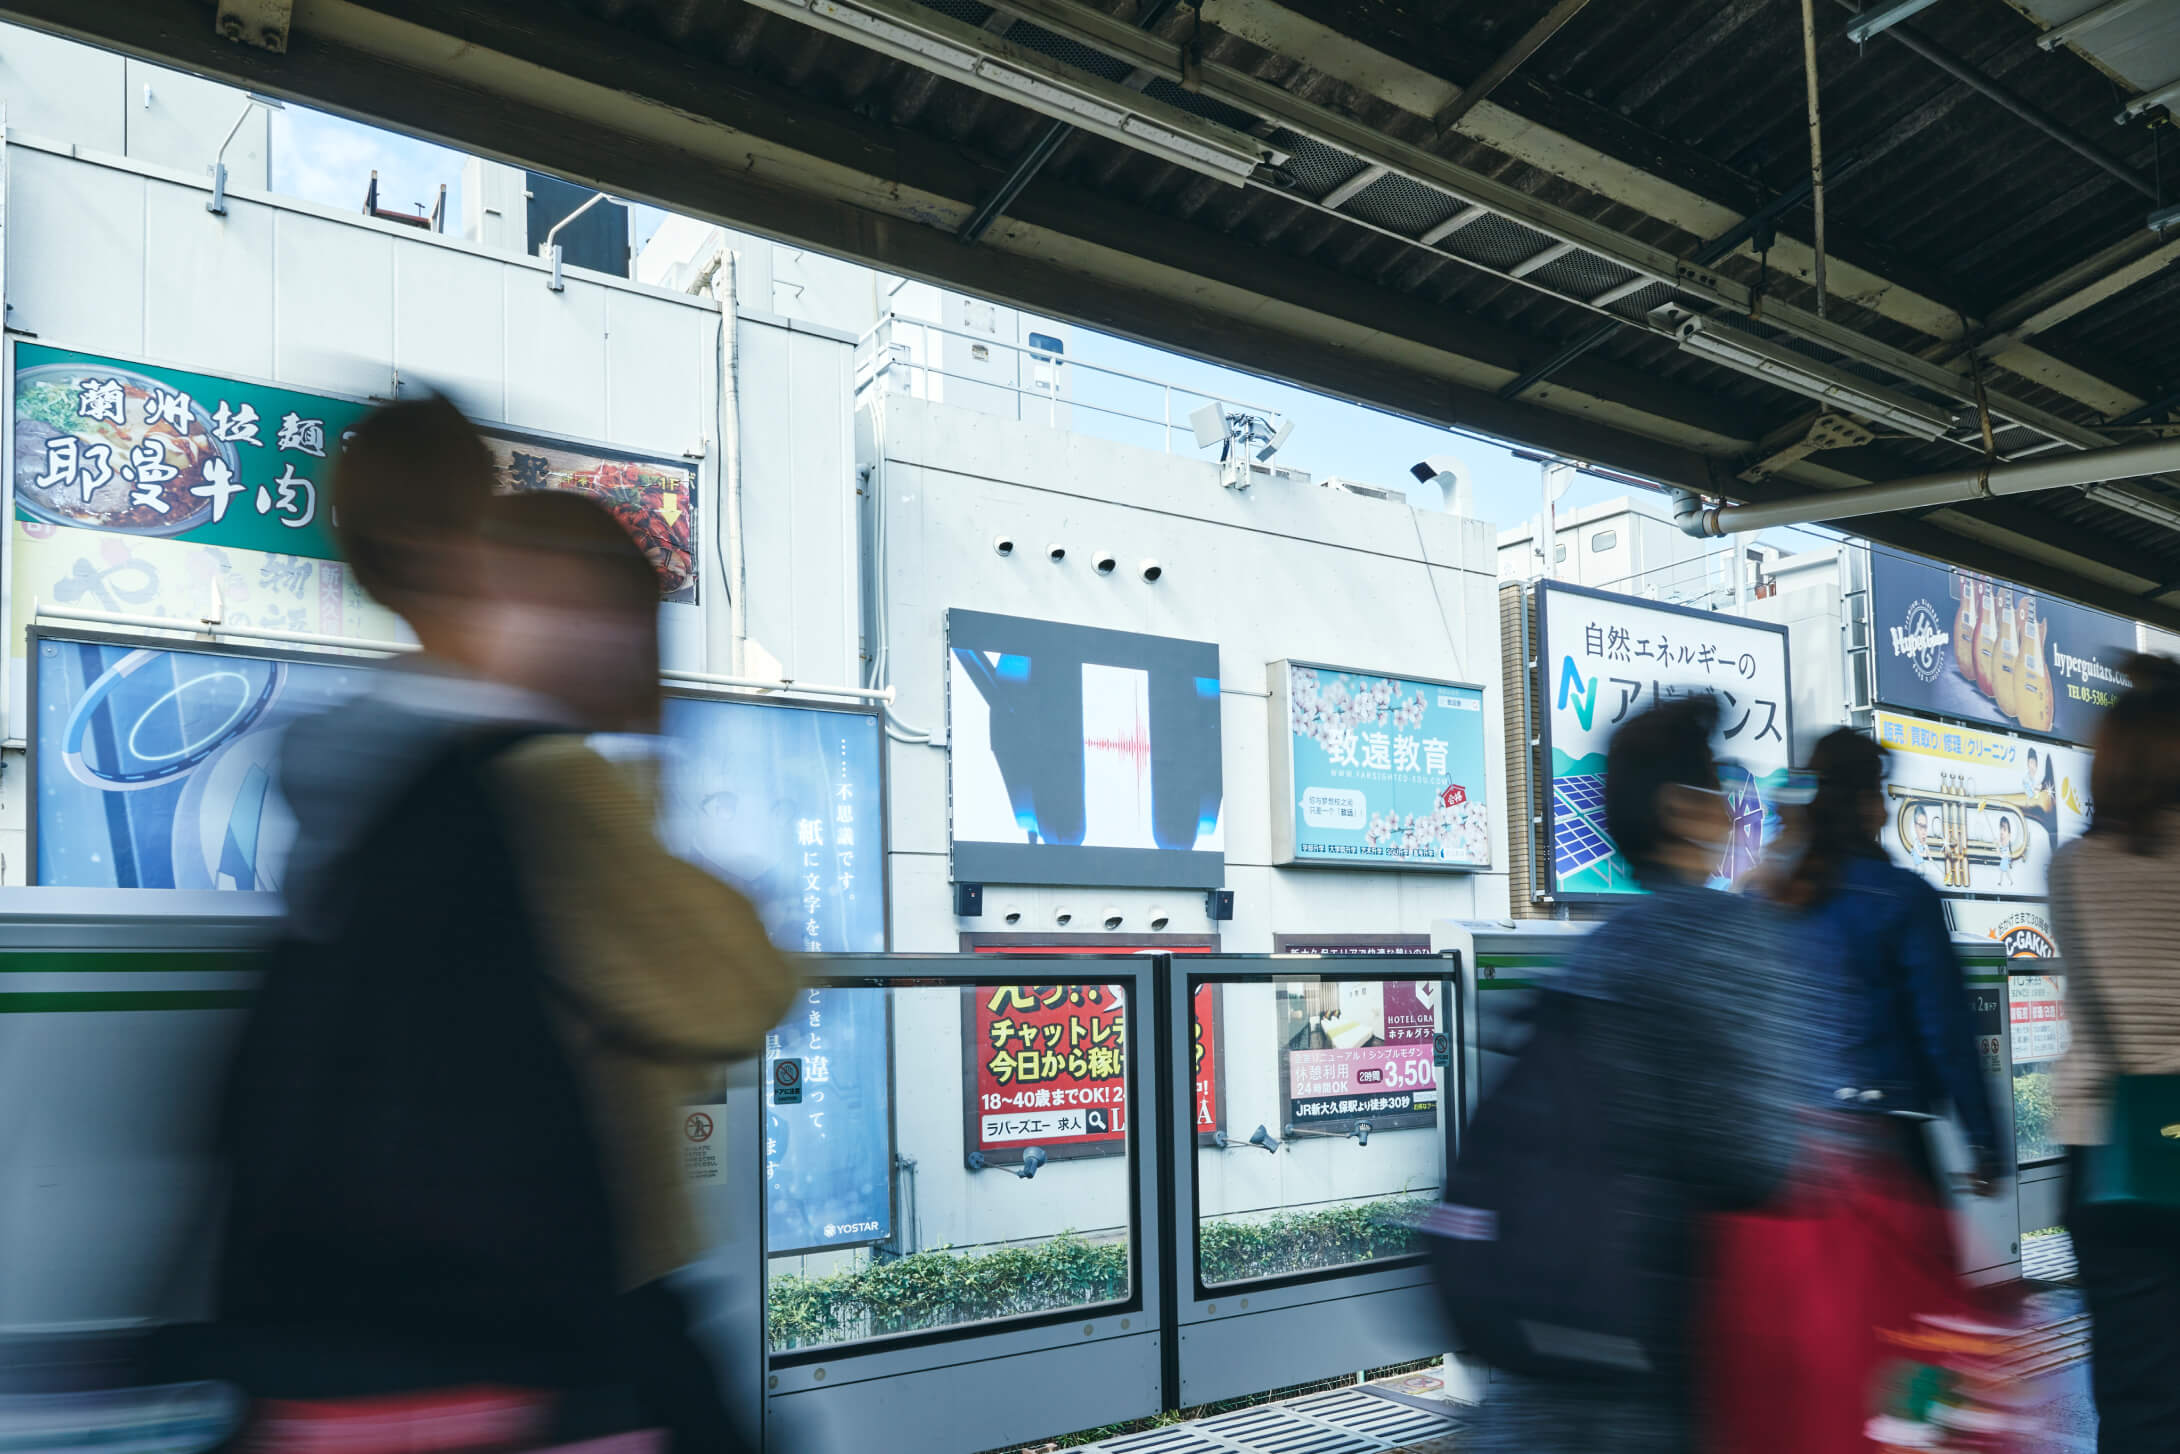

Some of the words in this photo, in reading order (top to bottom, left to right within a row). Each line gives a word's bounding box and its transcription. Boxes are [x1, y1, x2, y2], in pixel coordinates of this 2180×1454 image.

[36, 435, 338, 528] 耶曼牛肉
[1586, 622, 1756, 680] 自然エネルギーの
[1328, 730, 1449, 775] 致遠教育
[1388, 1015, 1416, 1025] HOTEL
[1389, 1027, 1435, 1040] ホテルグラ
[1295, 1063, 1349, 1081] 休憩利用
[1297, 1081, 1349, 1095] 24時間OK
[1296, 1096, 1410, 1117] JR新大久保駅より徒歩30秒
[987, 1120, 1052, 1137] ラバーズエー
[1058, 1117, 1082, 1132] 求人
[836, 1220, 879, 1236] YOSTAR
